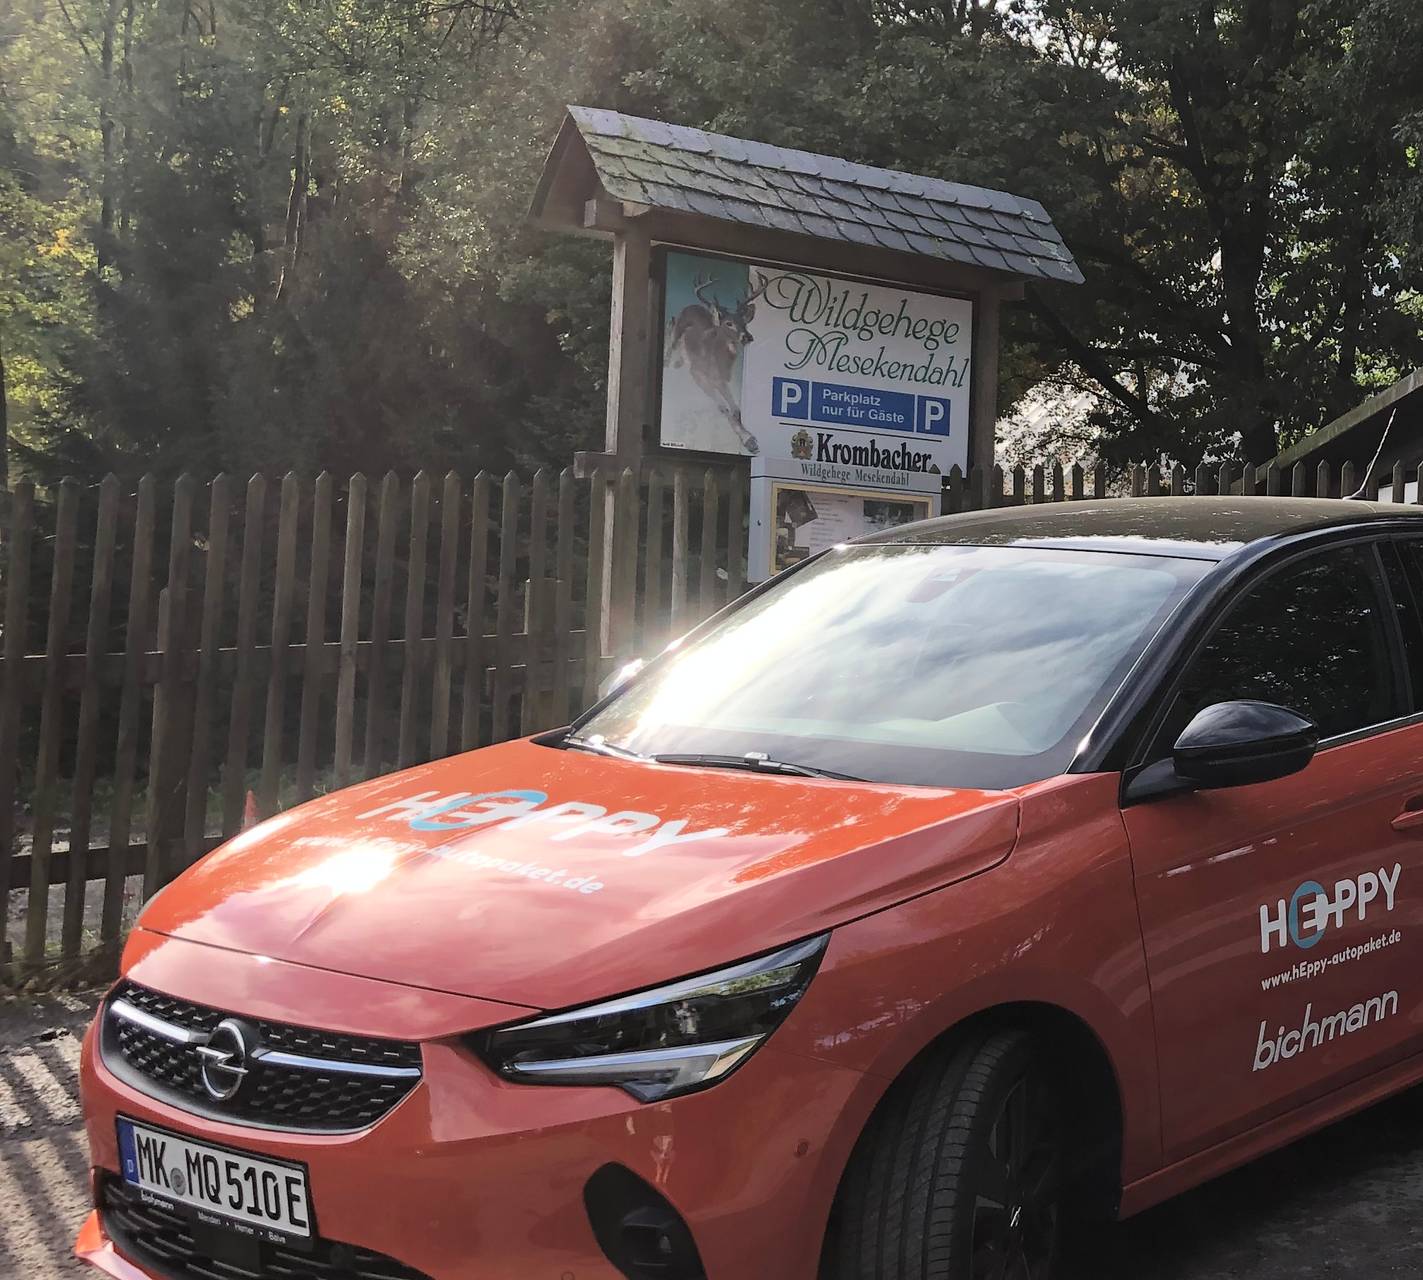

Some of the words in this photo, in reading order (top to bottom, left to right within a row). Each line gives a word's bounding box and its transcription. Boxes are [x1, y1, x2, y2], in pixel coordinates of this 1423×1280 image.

[764, 272, 960, 351] Wildgehege
[784, 328, 969, 388] Mesekendahl
[780, 381, 802, 414] P
[822, 388, 881, 407] Parkplatz
[822, 404, 843, 416] nur
[846, 406, 865, 419] für
[868, 408, 905, 424] Gäste
[924, 400, 945, 431] P
[816, 432, 932, 473] Krombacher
[801, 463, 851, 483] Wildgehege
[855, 469, 910, 487] Mesekendahl
[1261, 928, 1402, 991] www.hEppy-autopaket.de
[1252, 989, 1399, 1072] bichmann
[136, 1133, 171, 1188] MK
